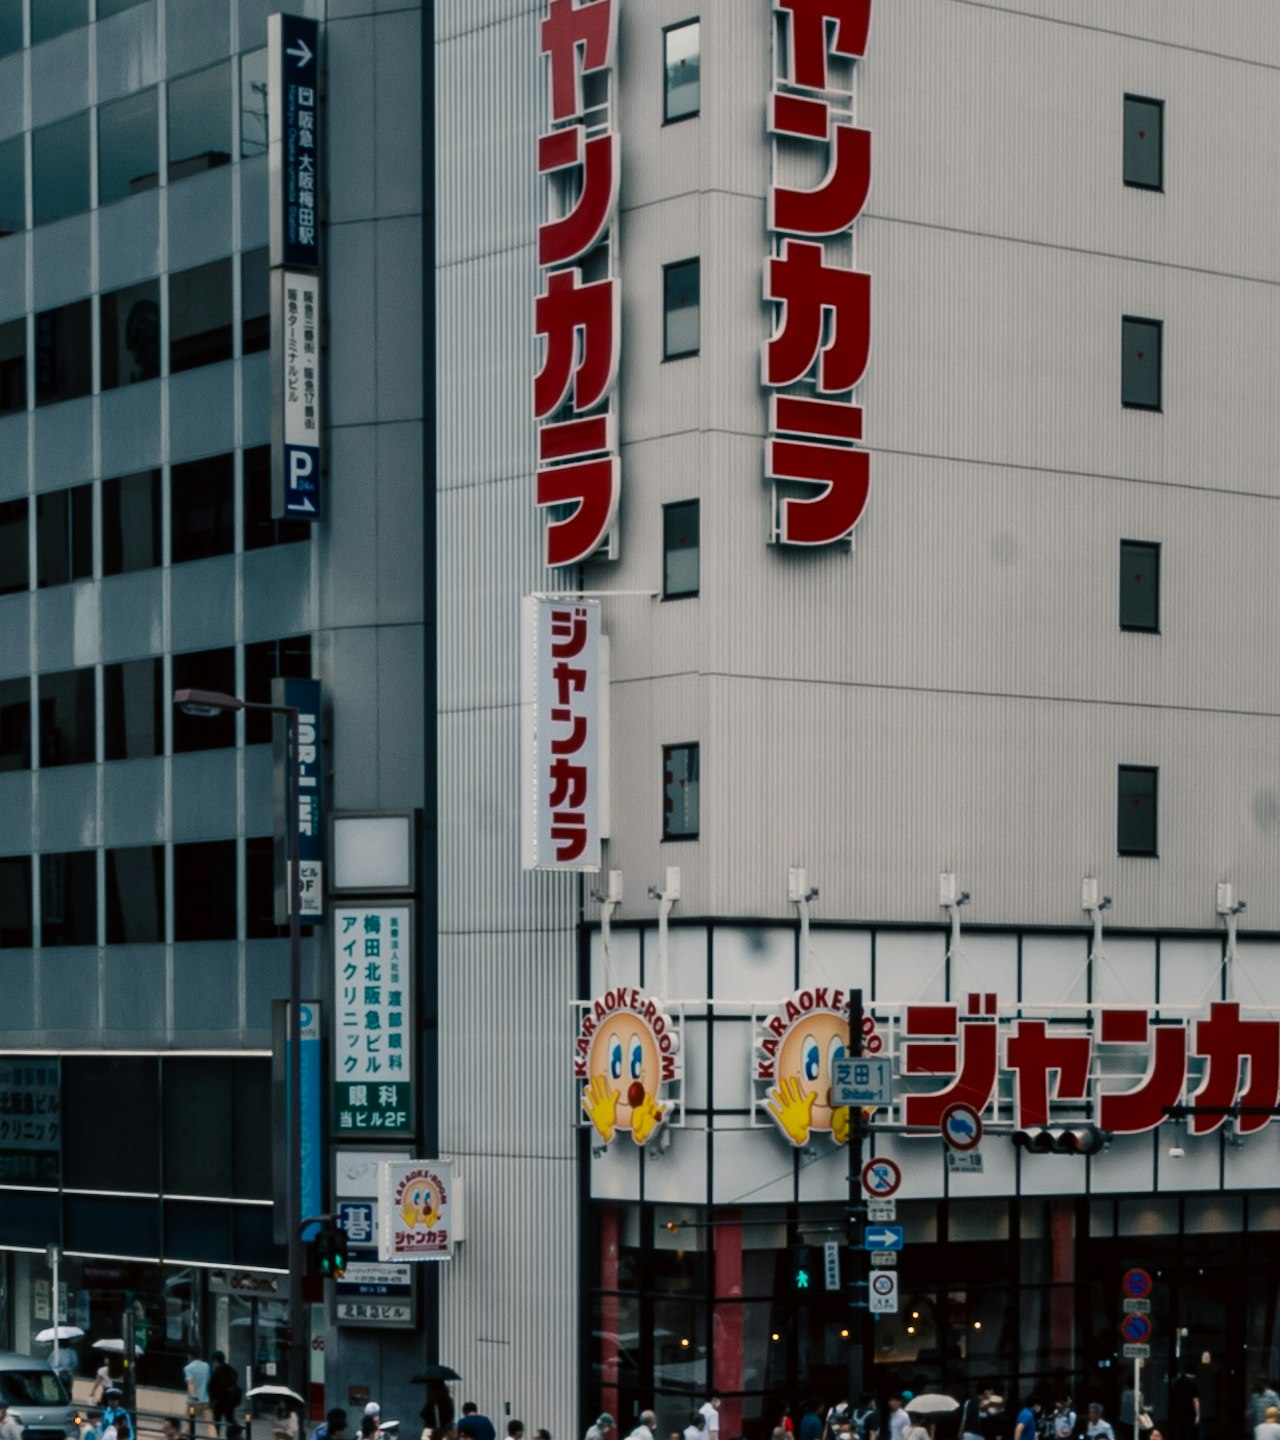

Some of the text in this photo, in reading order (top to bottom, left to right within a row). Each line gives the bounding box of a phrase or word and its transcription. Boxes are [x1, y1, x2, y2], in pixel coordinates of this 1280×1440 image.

[290, 450, 313, 490] P
[549, 607, 588, 862] ジャンカラ
[341, 916, 359, 1074] アイクリニック
[363, 914, 382, 1074] 梅田北阪急ビル
[835, 1064, 885, 1086] 芝田 1
[348, 1084, 398, 1108] 眼科
[395, 1230, 448, 1245] ジャンカラ
